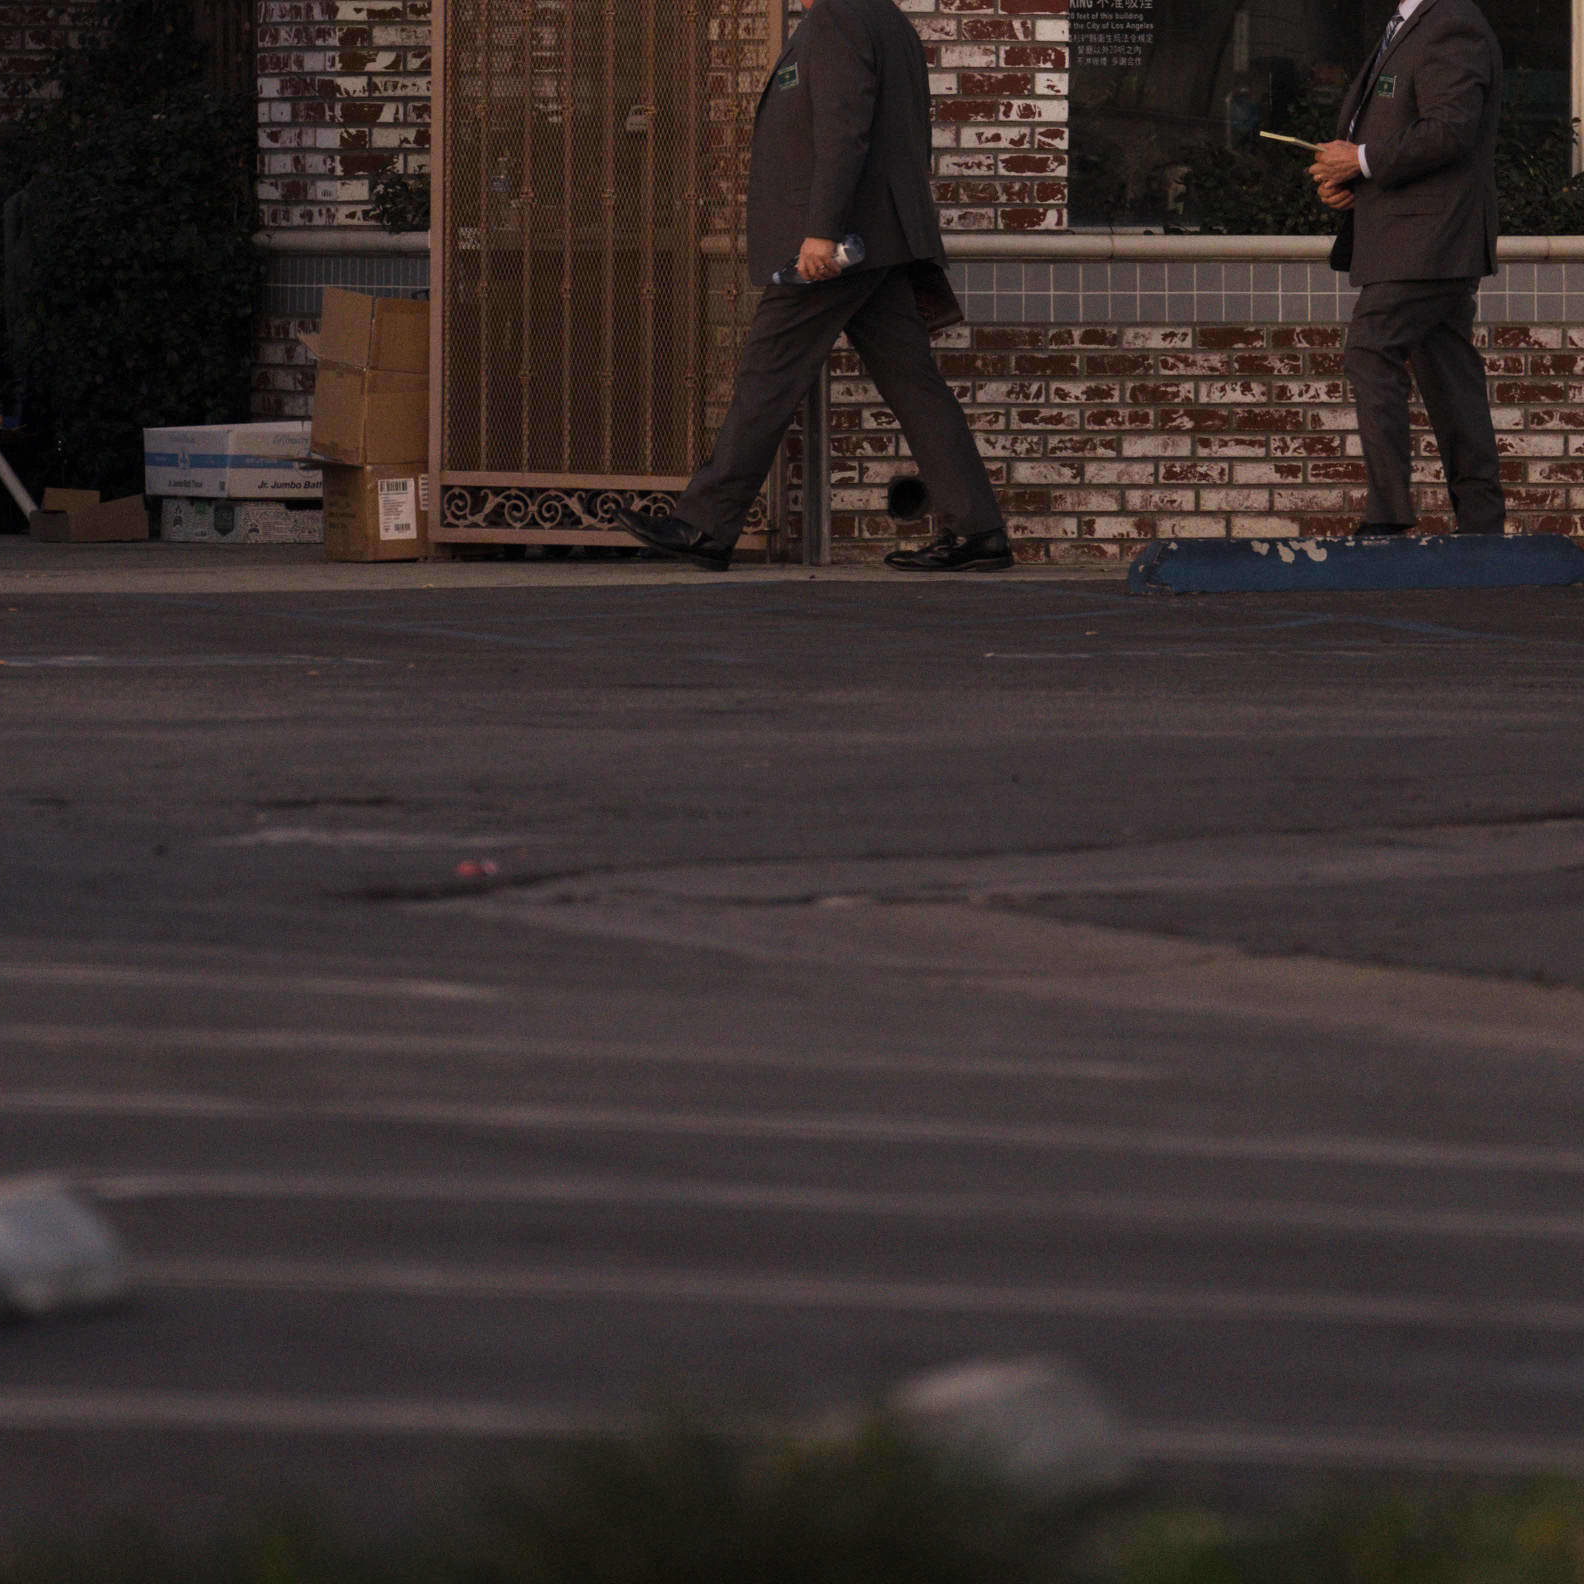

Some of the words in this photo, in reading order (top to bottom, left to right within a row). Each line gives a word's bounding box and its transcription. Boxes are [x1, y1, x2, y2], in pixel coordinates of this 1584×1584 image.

[1086, 22, 1100, 32] City
[1111, 22, 1125, 30] Los
[1126, 22, 1154, 32] Angeles
[271, 480, 302, 489] Jumbo
